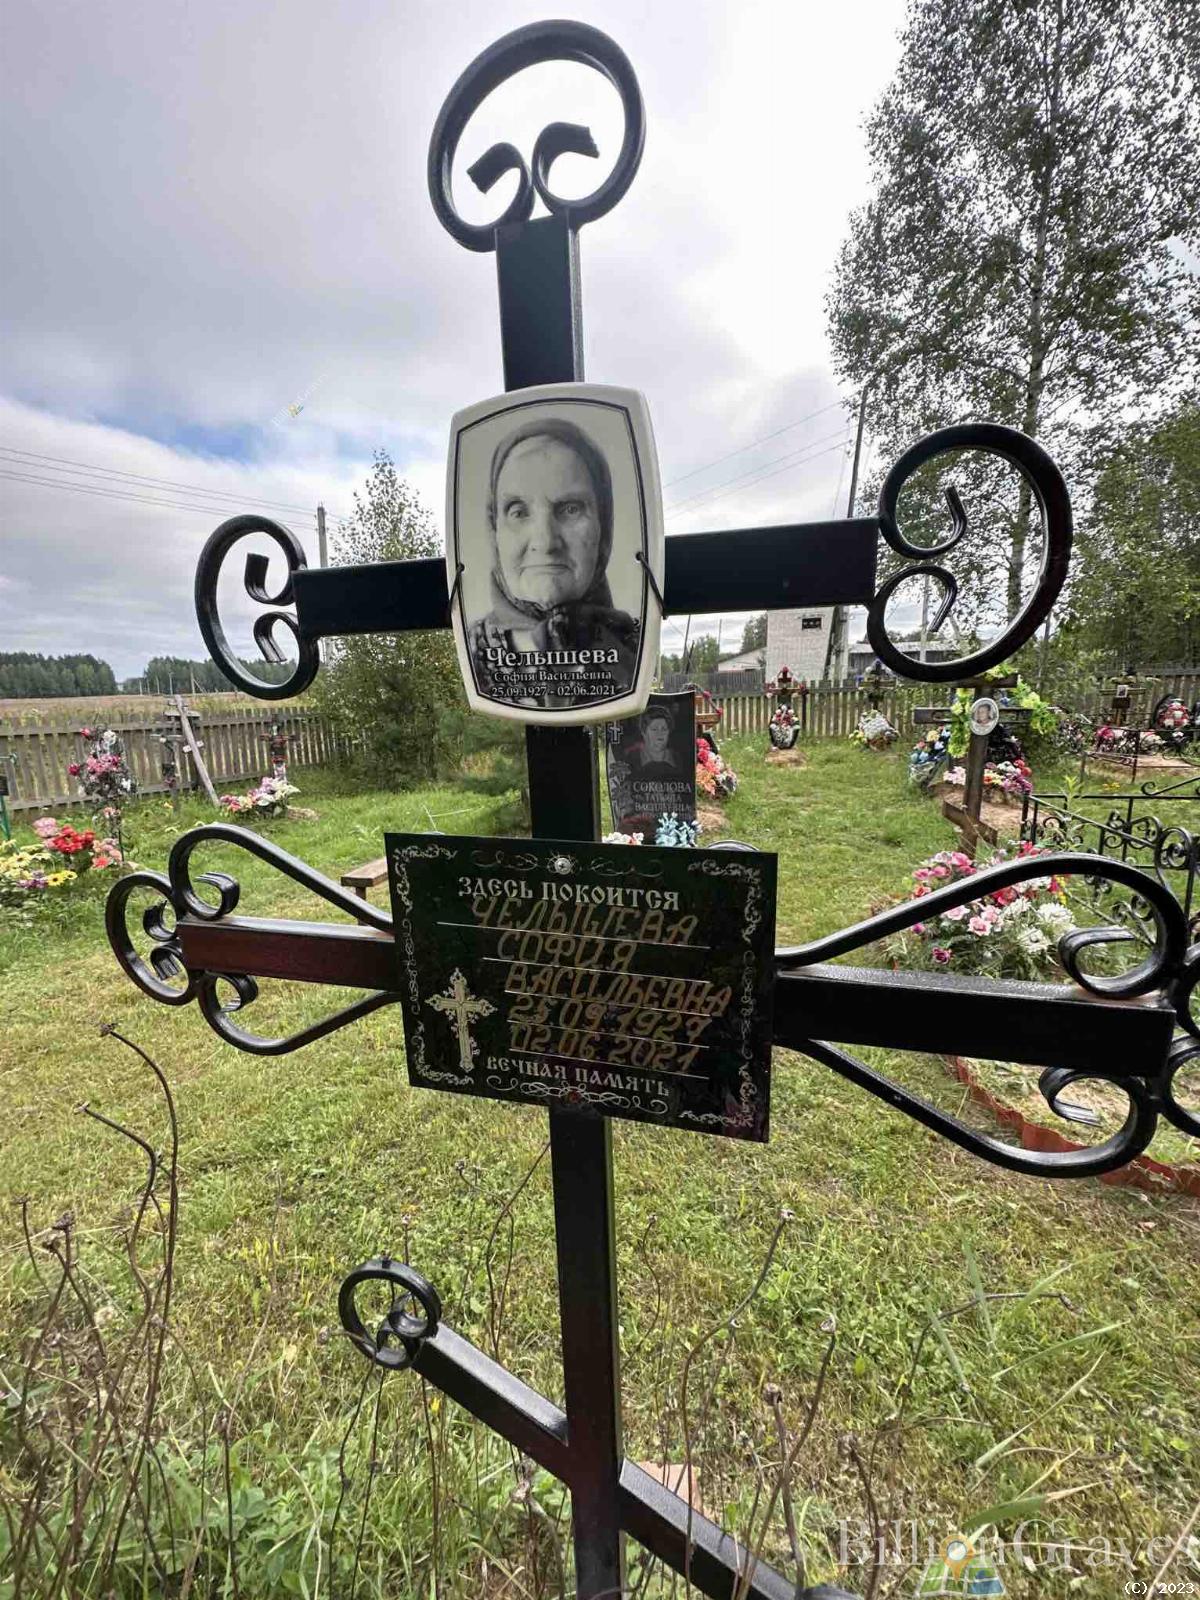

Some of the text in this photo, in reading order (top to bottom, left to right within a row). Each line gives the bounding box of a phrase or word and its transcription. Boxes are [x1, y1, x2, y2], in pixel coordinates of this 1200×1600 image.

[485, 647, 619, 667] Челышева
[494, 671, 612, 684] София Васильевна
[492, 686, 547, 697] 25.09.1927
[557, 684, 616, 696] 02.06.2021
[633, 781, 692, 793] СОКОЛОВА
[458, 876, 680, 912] ЗДЕСЬ ПОКОИТСЯ
[498, 930, 638, 973] СОФИЯ
[487, 1055, 670, 1097] ВЕЧНАЯ ПАМЯТЬ
